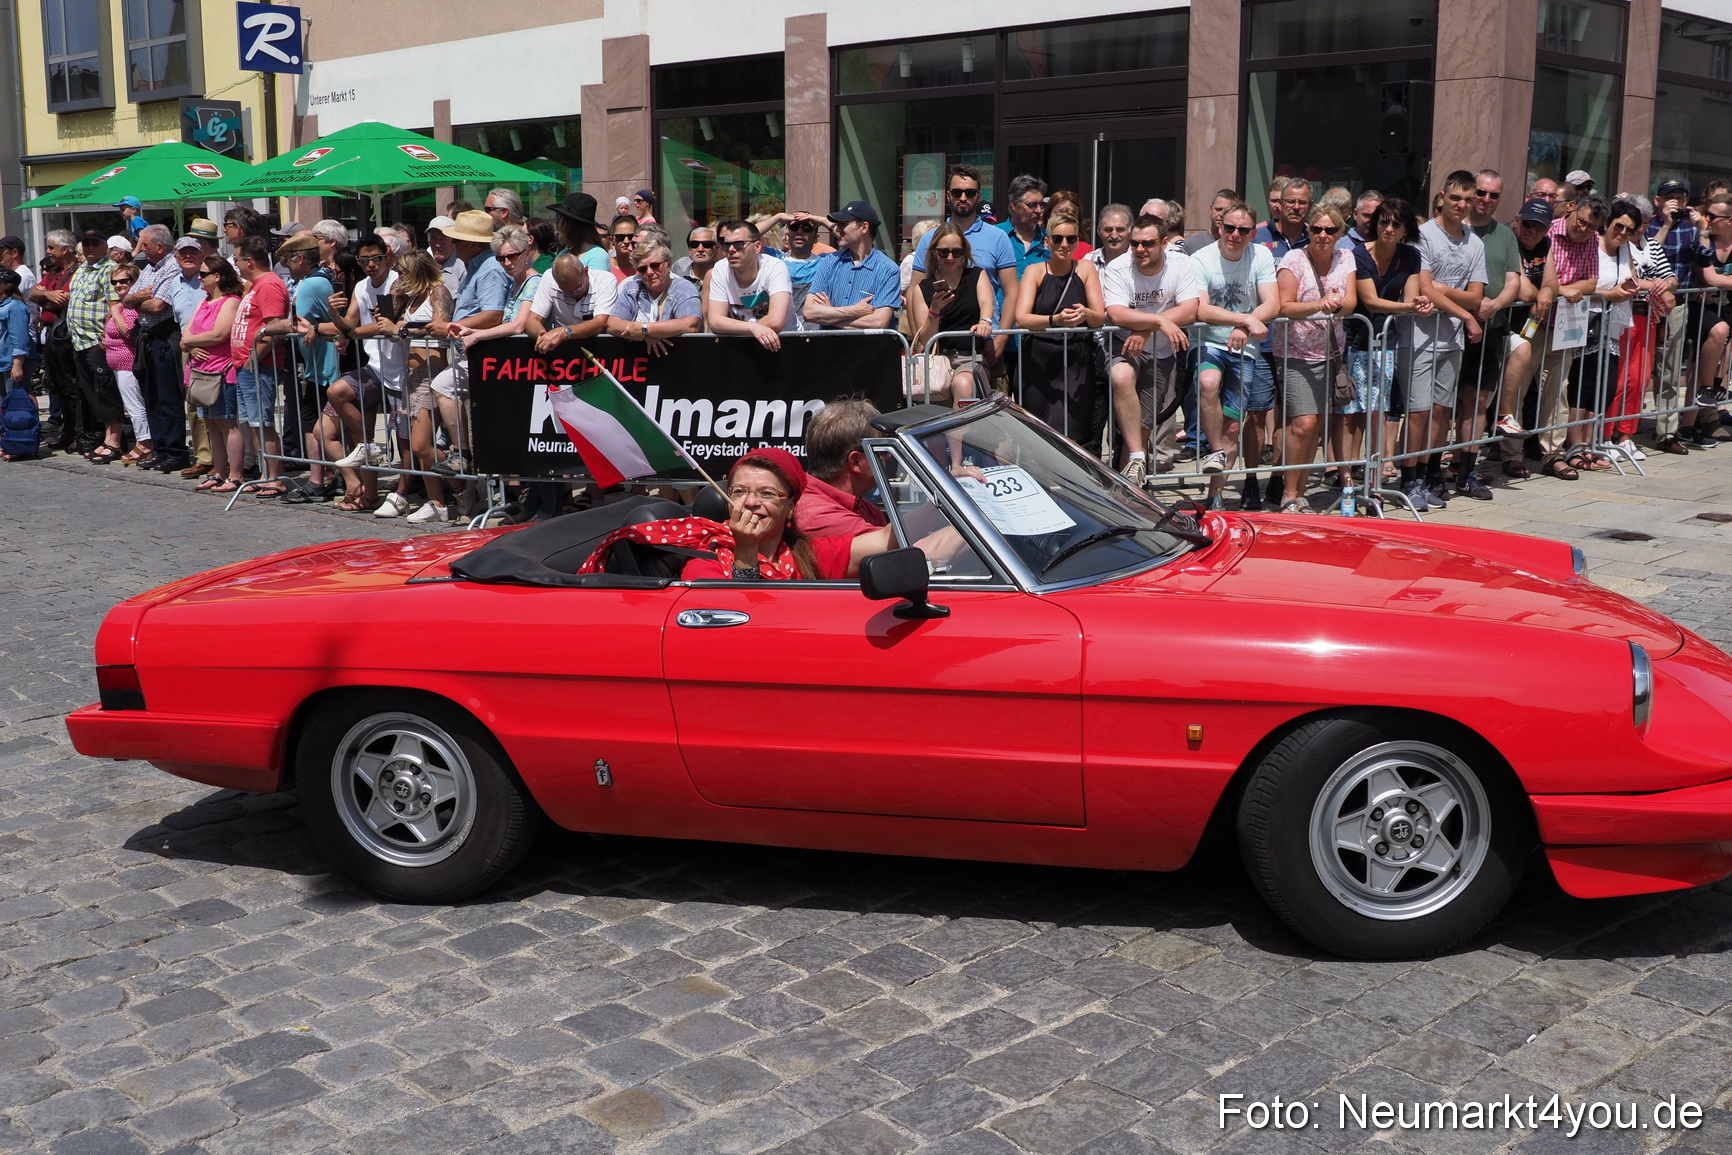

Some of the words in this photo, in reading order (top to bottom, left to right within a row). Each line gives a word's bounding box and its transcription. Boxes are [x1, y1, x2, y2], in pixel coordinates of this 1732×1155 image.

[310, 94, 330, 106] Unterer
[331, 90, 348, 103] Markt
[349, 89, 356, 101] 15
[753, 165, 782, 176] Grillen
[482, 357, 649, 383] FAHRSCHULE
[529, 384, 826, 438] Klmann
[528, 437, 578, 453] Neuma
[682, 440, 750, 460] Freystadt
[985, 476, 1023, 497] 233
